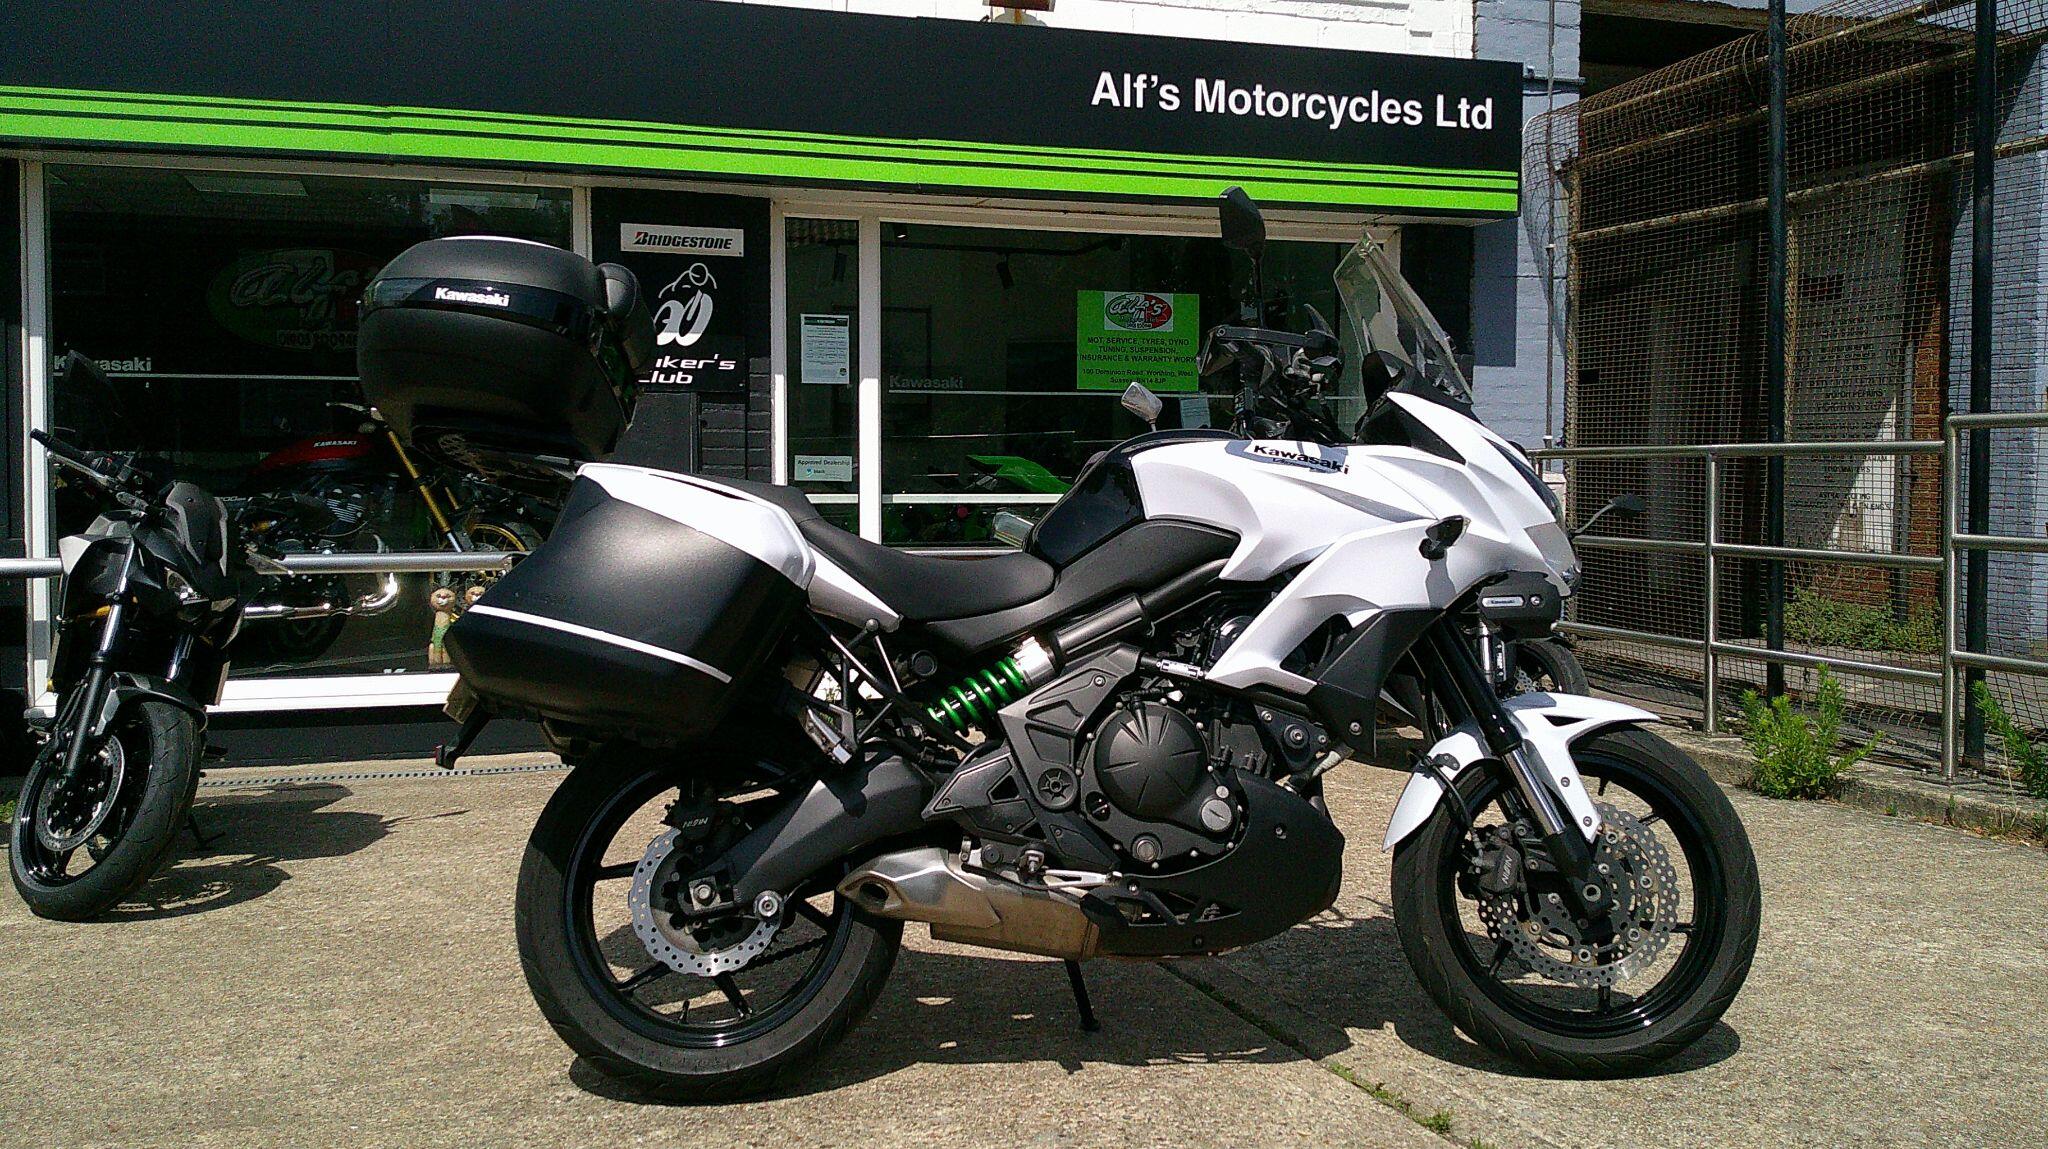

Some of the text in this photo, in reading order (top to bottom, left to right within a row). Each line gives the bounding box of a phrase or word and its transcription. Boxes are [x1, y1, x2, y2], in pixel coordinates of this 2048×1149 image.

[1090, 71, 1494, 130] Alf's Motorcycles Ltd
[633, 231, 733, 250] BRIDGESTONE
[434, 287, 510, 307] Kawasaki
[53, 354, 152, 371] Kasaki
[655, 353, 737, 371] iker's
[1079, 354, 1123, 362] INSURANCE
[638, 371, 693, 384] lub
[889, 375, 963, 389] Kawasaki
[313, 440, 358, 448] KAWASAKI
[797, 459, 850, 467] Approved Dealership
[1253, 445, 1349, 475] Kawasaki
